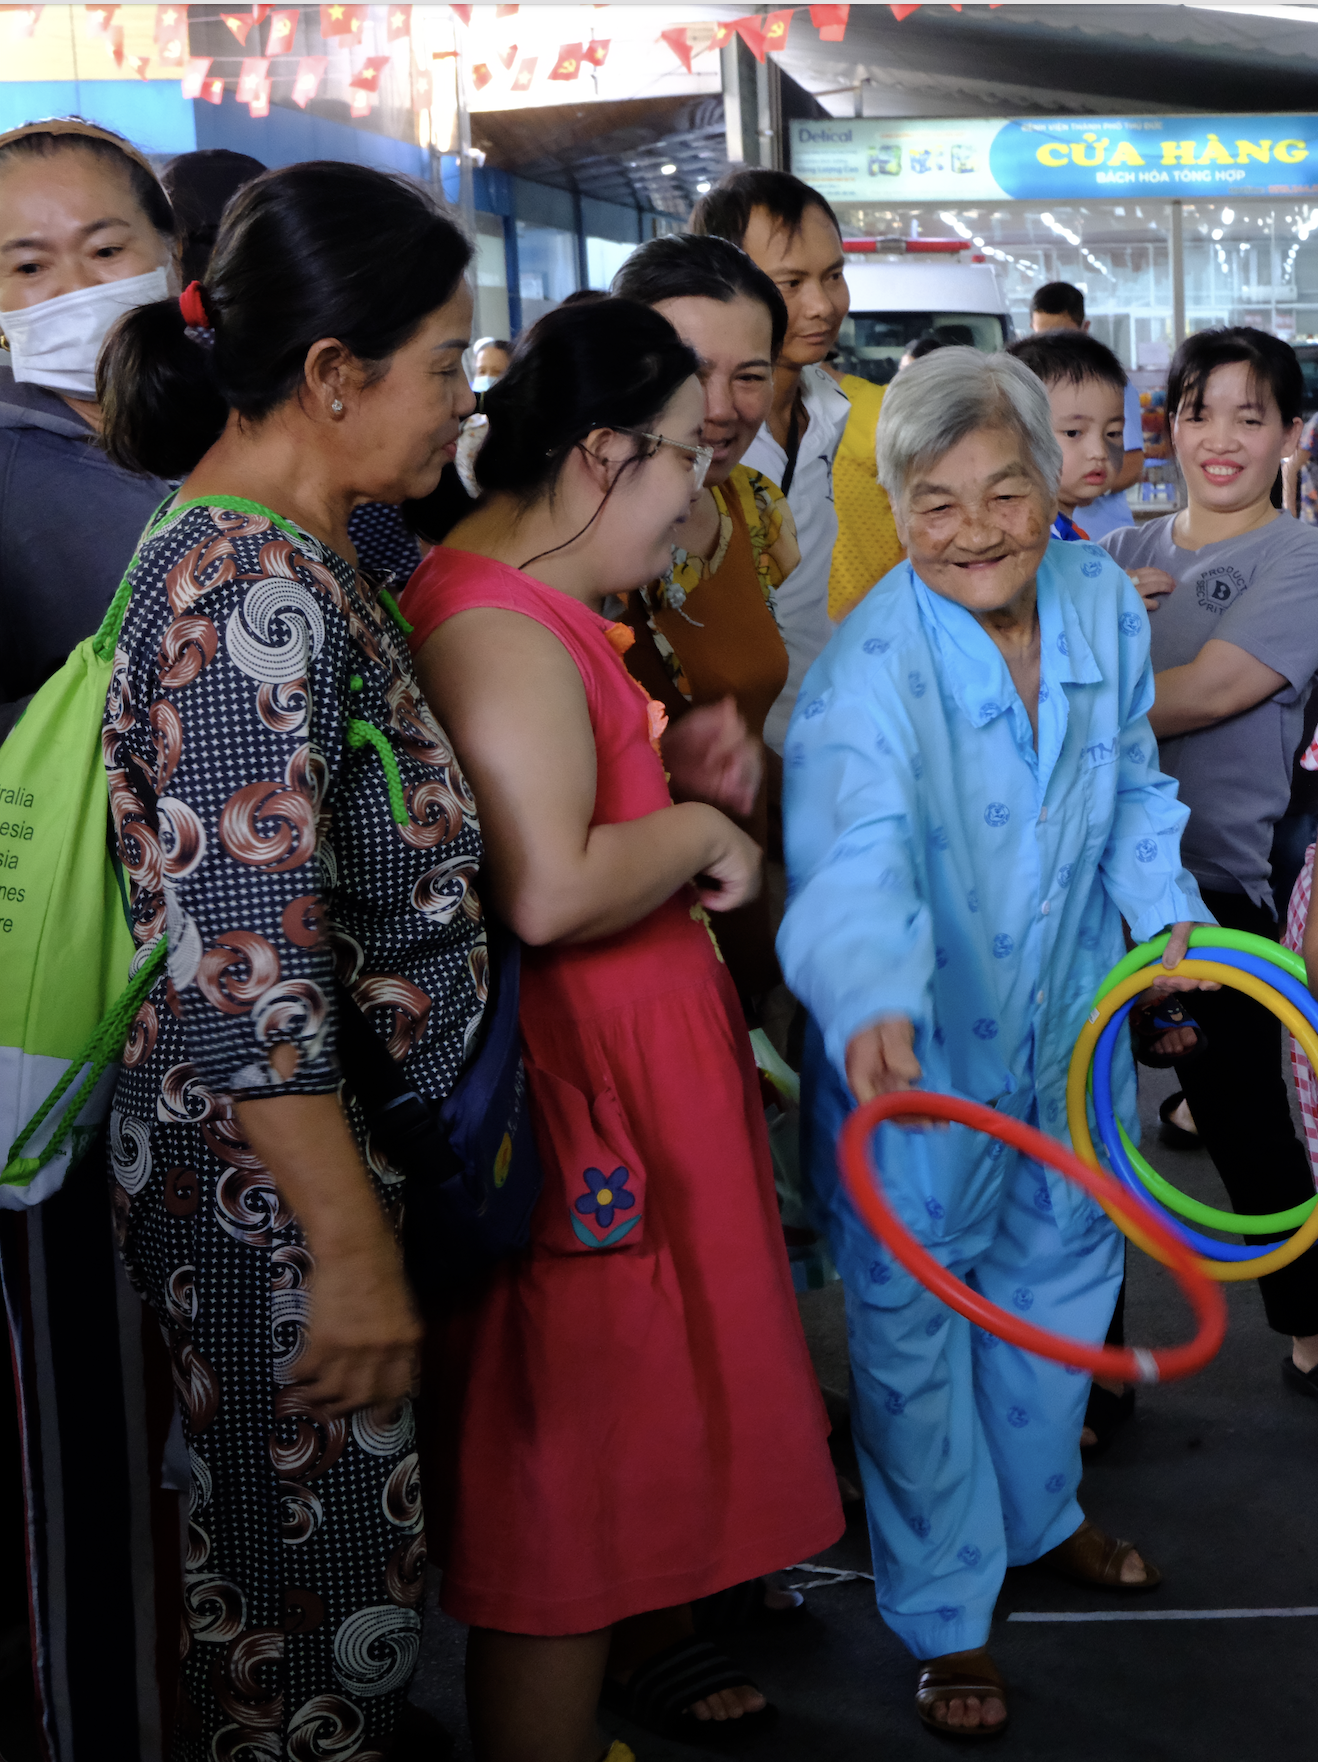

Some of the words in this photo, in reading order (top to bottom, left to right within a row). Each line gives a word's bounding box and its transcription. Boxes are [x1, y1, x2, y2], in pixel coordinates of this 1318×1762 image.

[1036, 133, 1146, 167] CỬA
[1160, 133, 1310, 166] HÀNG
[1201, 565, 1248, 592] PRODUCT
[1196, 580, 1226, 616] SECURIT
[0, 784, 35, 808] ralia
